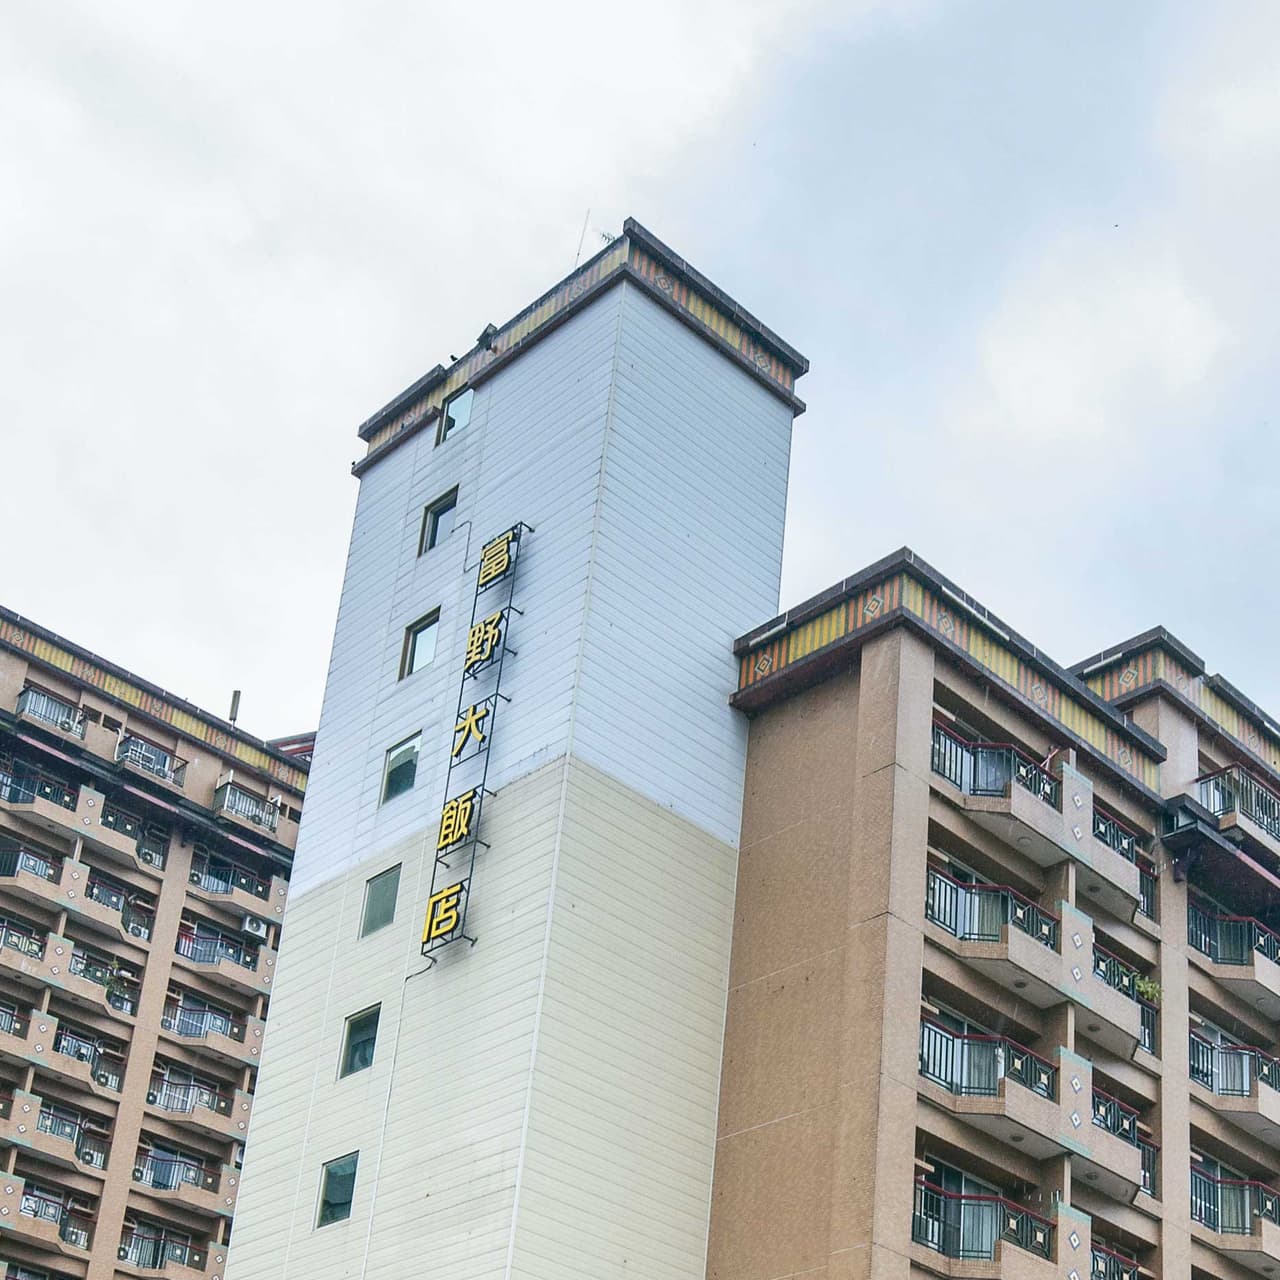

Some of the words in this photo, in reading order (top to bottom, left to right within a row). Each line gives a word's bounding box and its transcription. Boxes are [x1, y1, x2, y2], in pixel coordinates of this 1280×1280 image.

[421, 530, 514, 942] 富野大飯店
